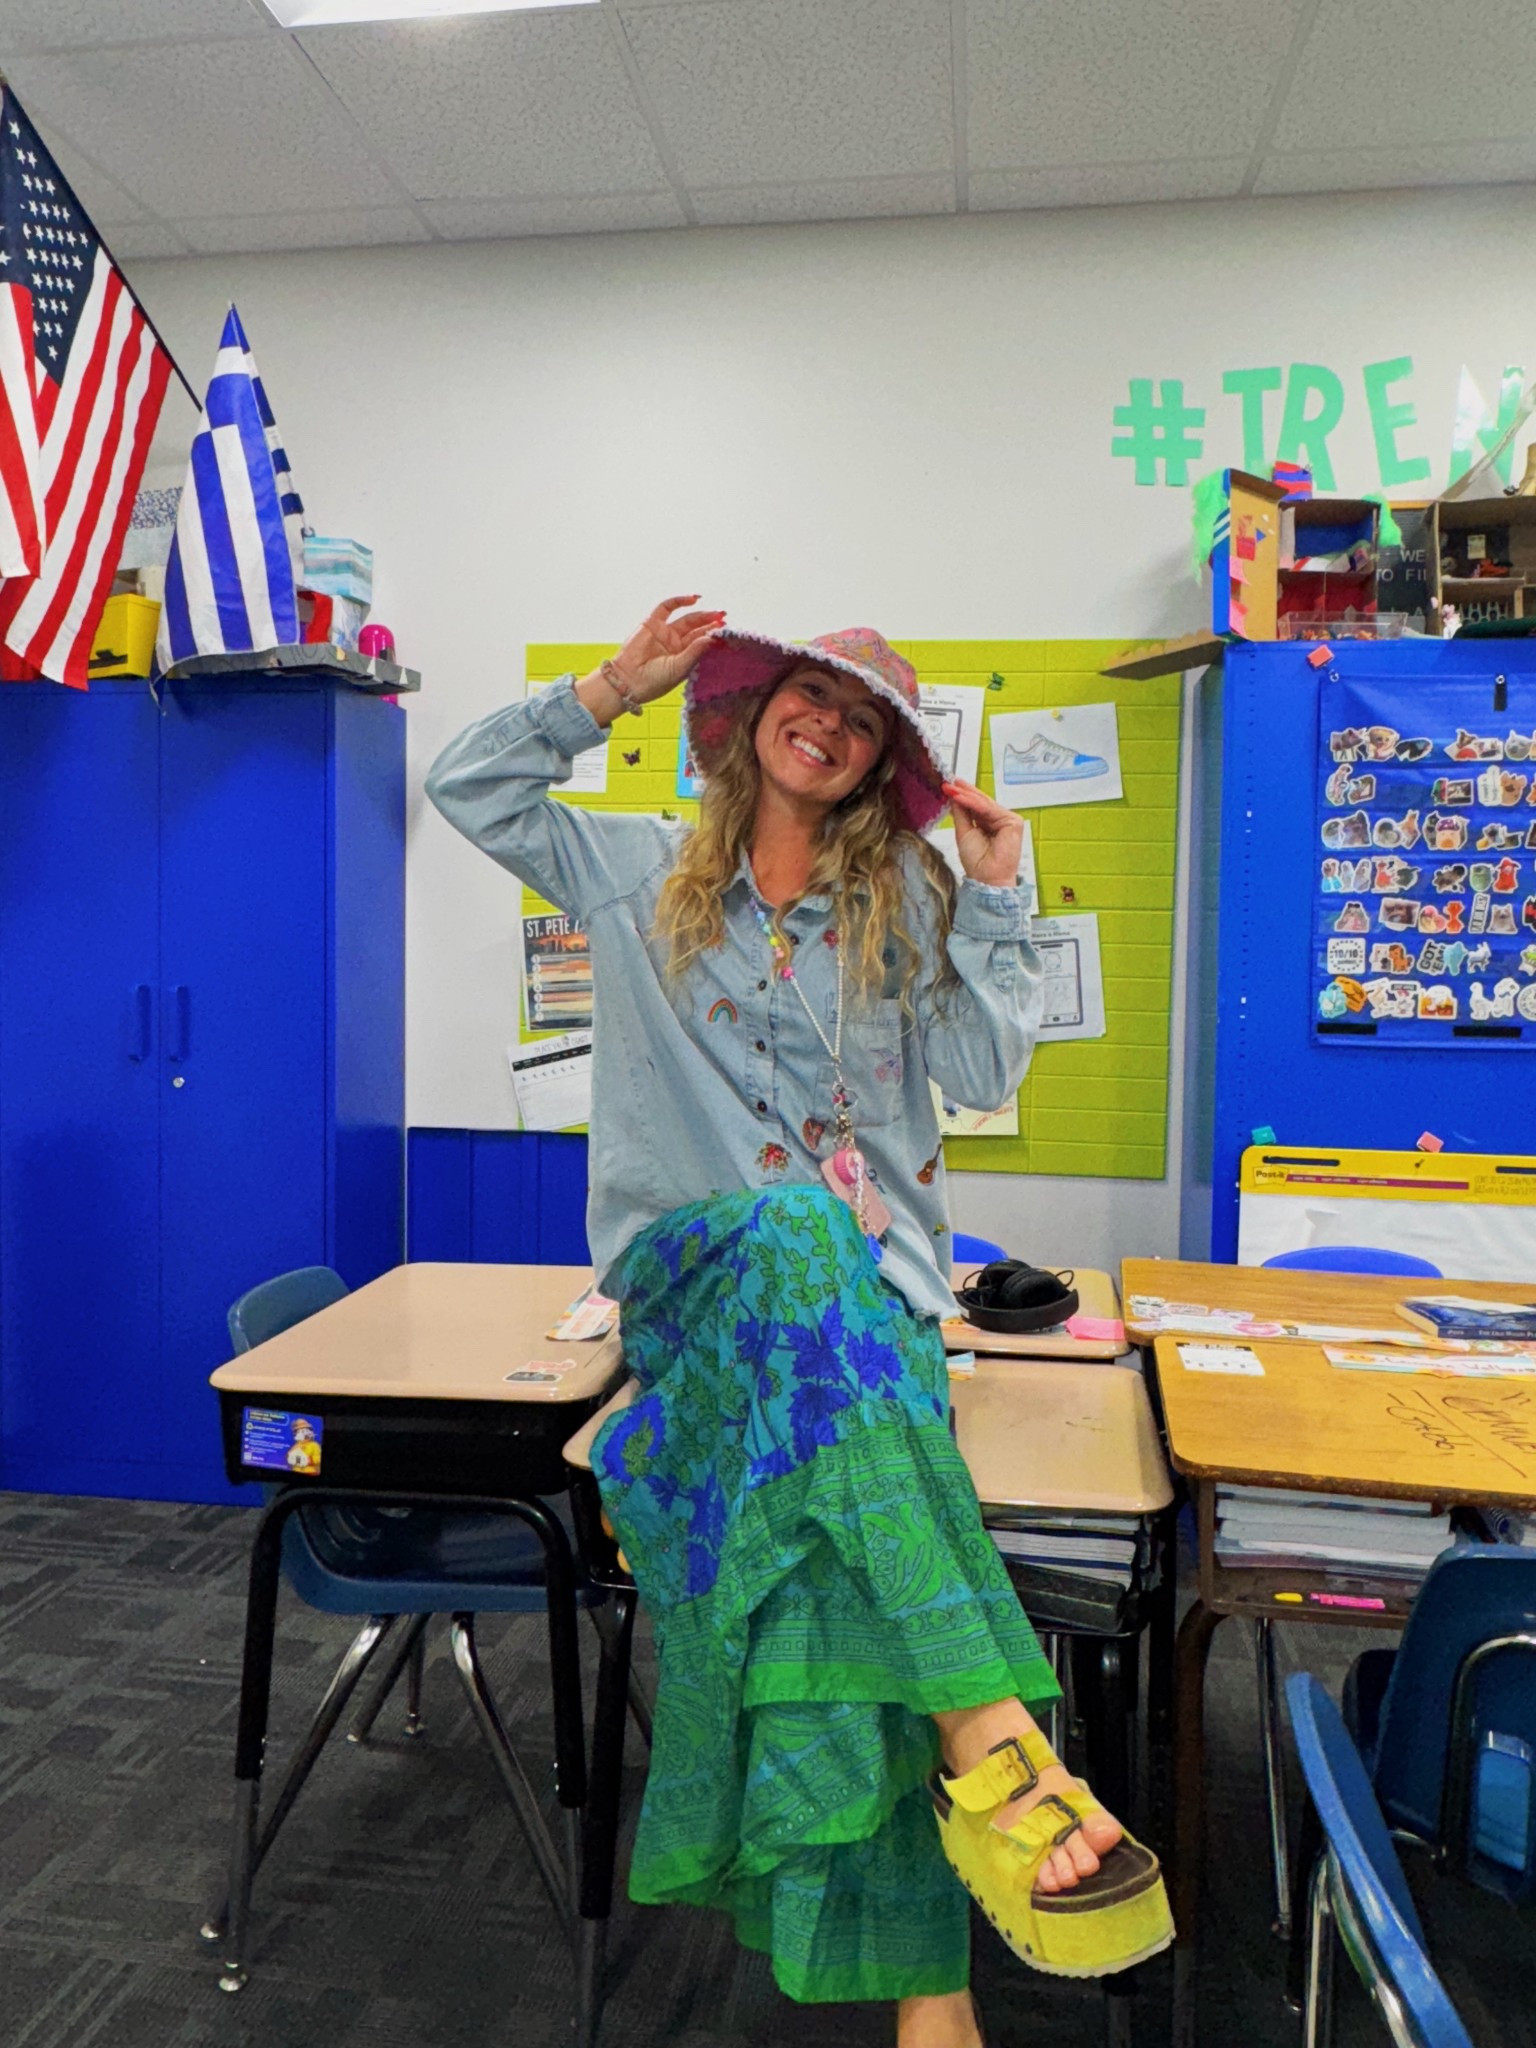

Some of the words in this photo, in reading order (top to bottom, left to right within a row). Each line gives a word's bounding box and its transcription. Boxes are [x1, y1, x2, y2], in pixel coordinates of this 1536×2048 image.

[526, 920, 544, 938] ST.
[545, 916, 571, 936] PETE
[1420, 942, 1438, 970] GOT
[1255, 1169, 1285, 1179] Post-it
